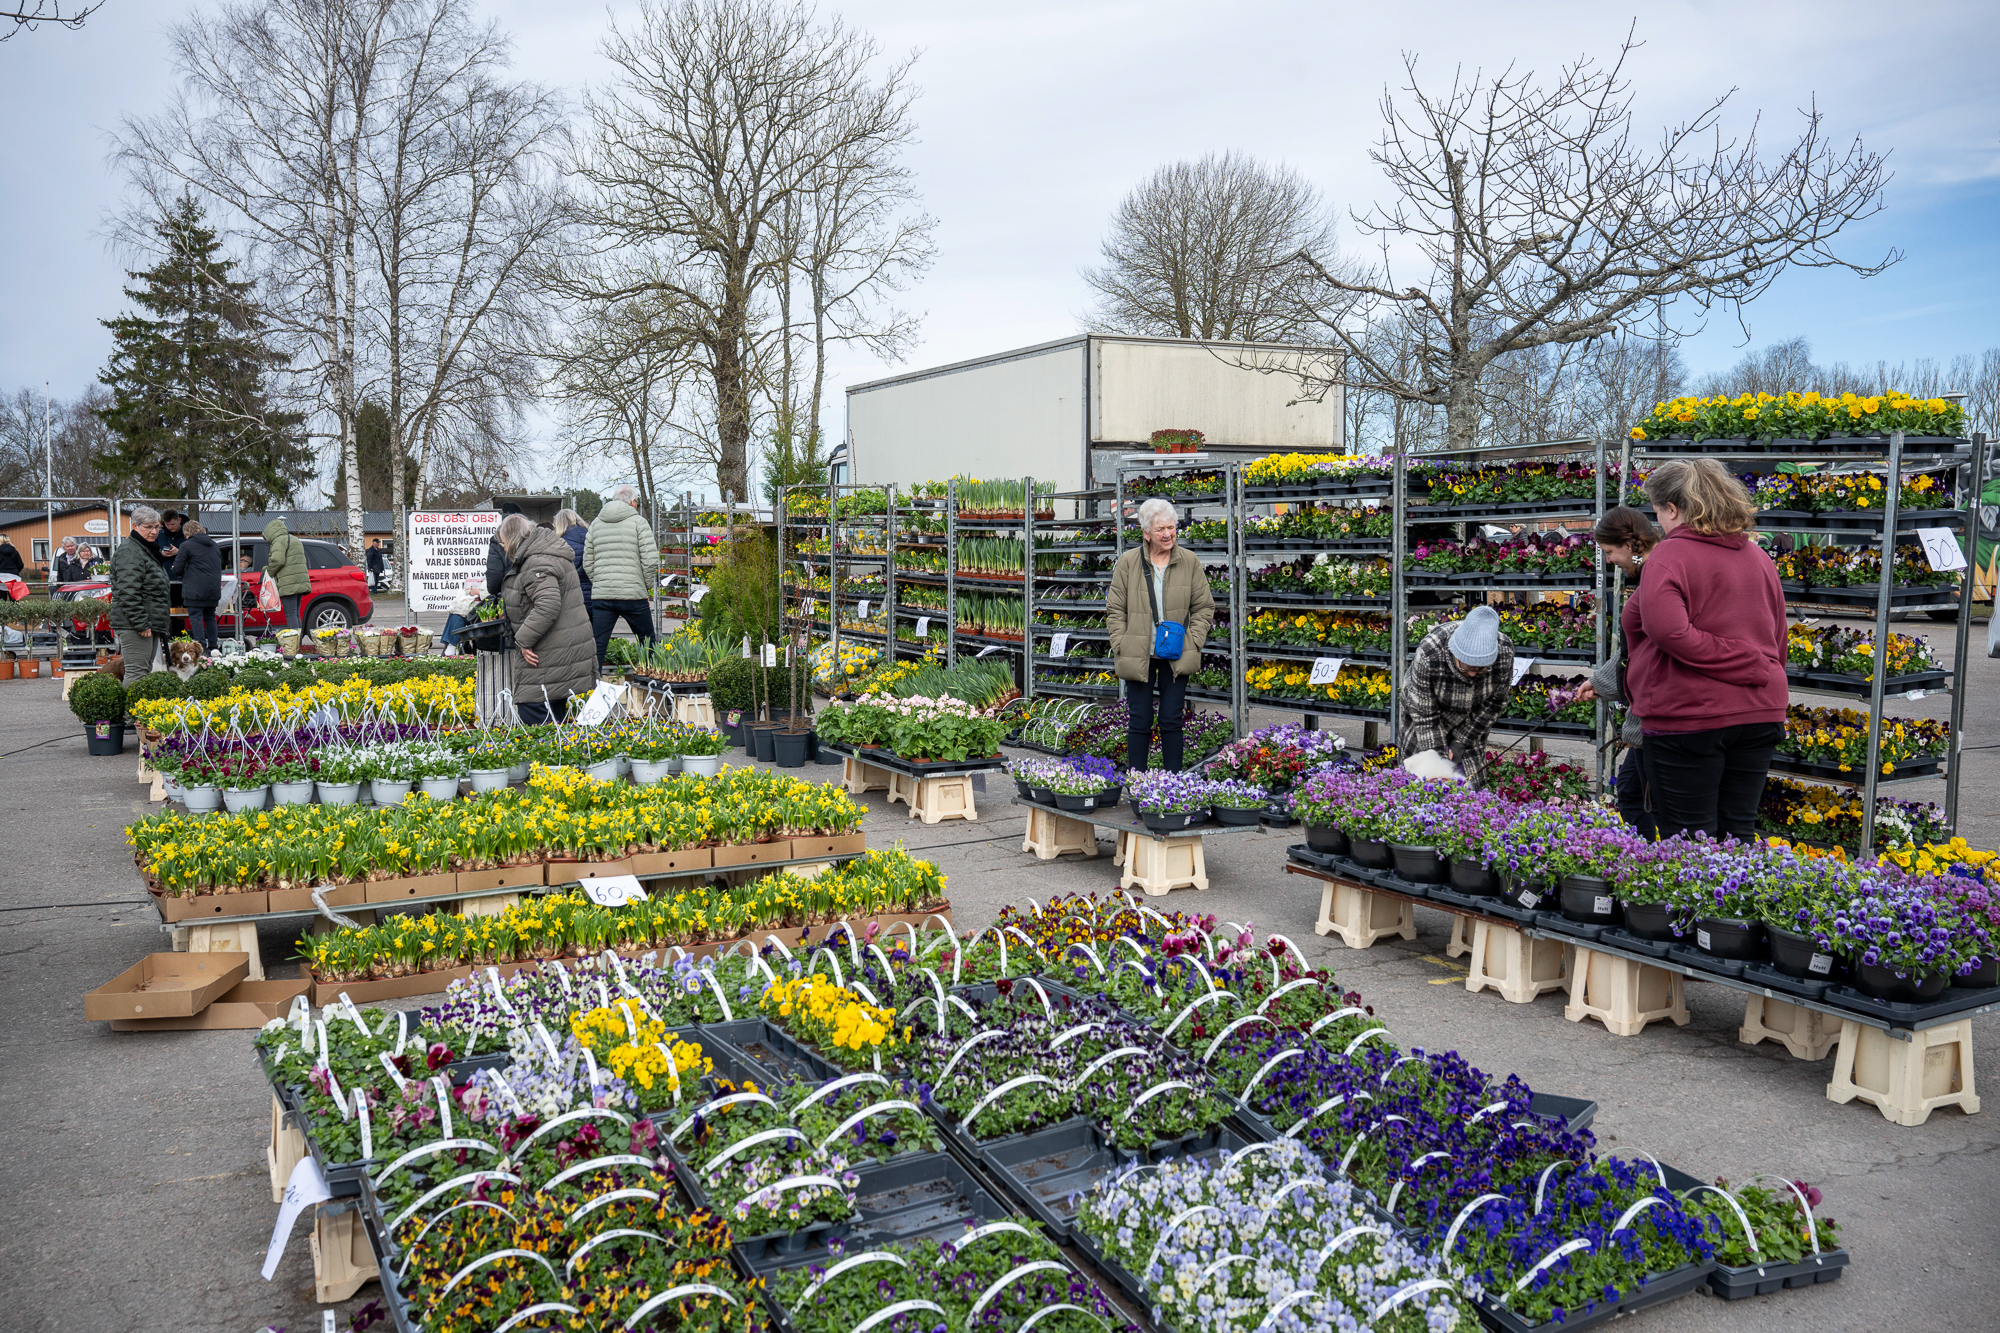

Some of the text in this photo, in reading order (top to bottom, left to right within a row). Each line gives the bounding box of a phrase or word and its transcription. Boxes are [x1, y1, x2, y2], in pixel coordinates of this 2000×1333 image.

[414, 514, 498, 523] OBS! OBS! OBS!
[415, 525, 497, 535] LAGERFÖRSÄLJNING
[423, 536, 489, 546] PÅ KVARNGATAN
[431, 547, 481, 556] I NOSSEBRO
[425, 556, 487, 567] VARJE SÖNDAG
[412, 570, 450, 580] MÄNGDER
[452, 572, 469, 580] MED
[422, 582, 439, 590] TILL
[440, 580, 460, 590] LÅGA
[422, 594, 457, 602] Götebor
